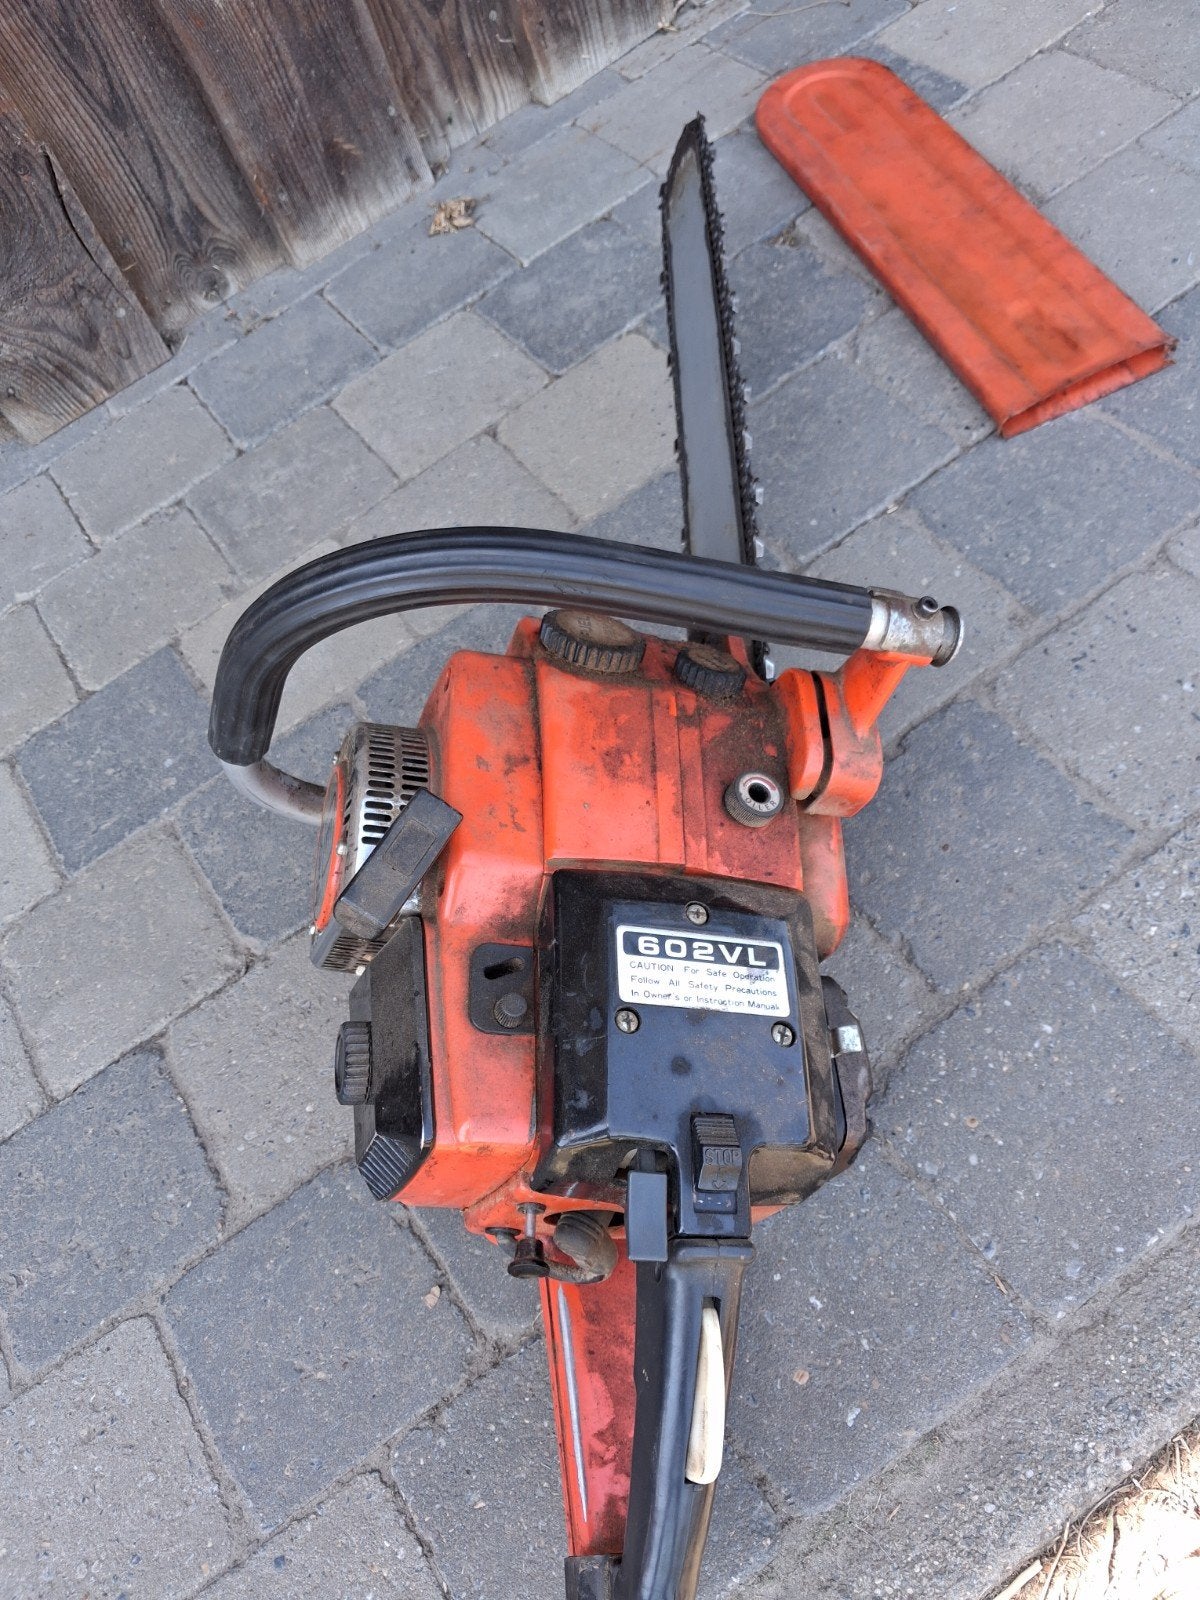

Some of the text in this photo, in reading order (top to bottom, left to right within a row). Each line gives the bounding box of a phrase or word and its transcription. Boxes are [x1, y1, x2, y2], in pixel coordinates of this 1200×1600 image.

[745, 797, 777, 810] OILER
[638, 936, 766, 966] 602VL
[629, 960, 776, 983] CAUTION For Safe Operation
[630, 975, 777, 997] Follow All Safety Precautions
[631, 989, 640, 997] In
[643, 990, 680, 1001] Owner's
[696, 995, 745, 1007] Instruction
[748, 1000, 780, 1010] Manual
[704, 1148, 740, 1165] STOP
